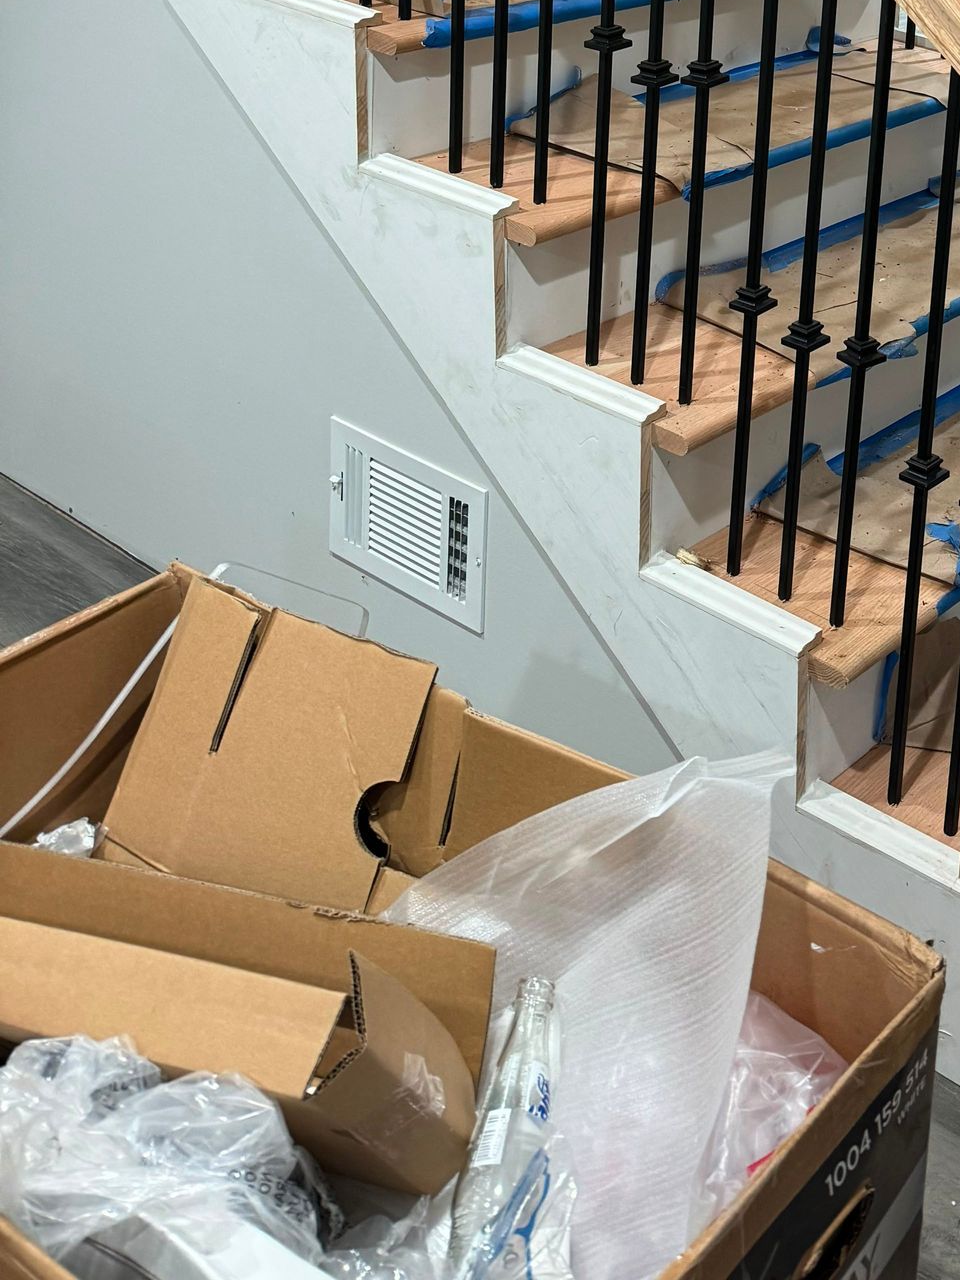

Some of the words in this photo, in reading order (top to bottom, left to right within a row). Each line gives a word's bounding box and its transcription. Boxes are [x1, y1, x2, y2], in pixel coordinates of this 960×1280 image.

[824, 1128, 872, 1197] 1004
[874, 1088, 902, 1136] 159
[905, 1047, 929, 1094] 514
